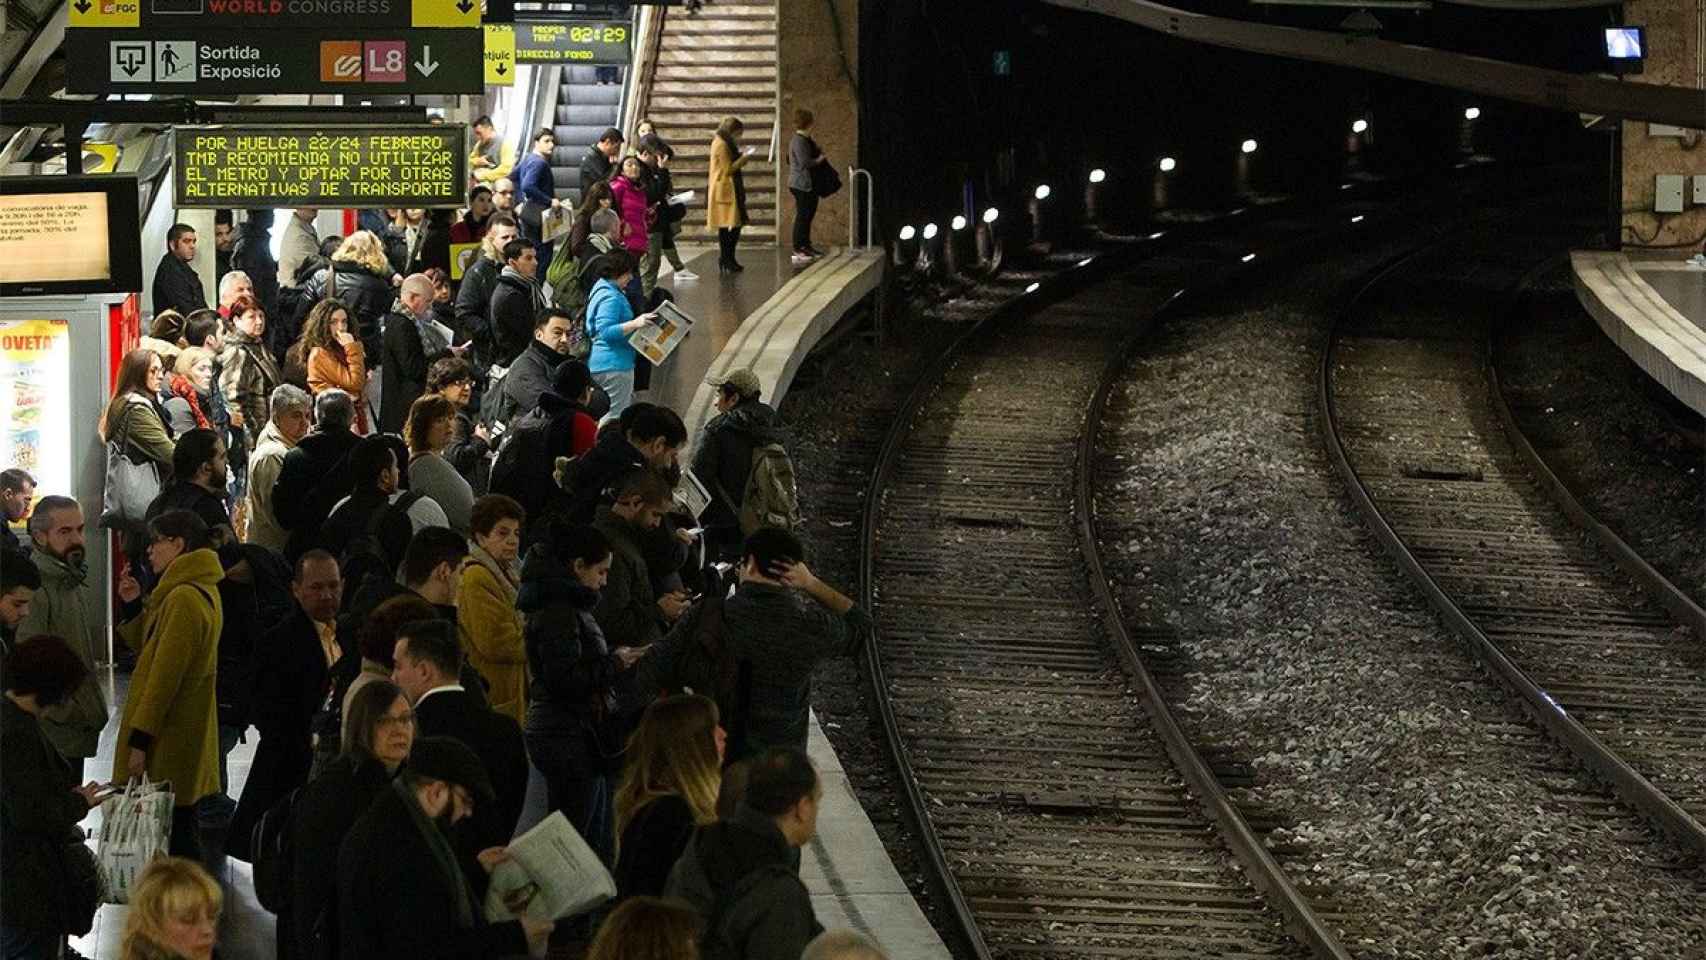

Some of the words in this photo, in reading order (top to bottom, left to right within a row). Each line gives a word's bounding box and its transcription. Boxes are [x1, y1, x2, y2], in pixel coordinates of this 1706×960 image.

[116, 4, 137, 13] FGC
[208, 0, 282, 13] WORLD
[288, 0, 391, 14] CONGRESS
[570, 26, 626, 43] 02:29
[200, 45, 260, 60] Sortida
[369, 49, 401, 73] L8
[200, 63, 281, 81] Exposició
[195, 136, 227, 150] POR
[237, 136, 300, 150] HUELGA
[308, 136, 361, 150] 22/24
[369, 136, 443, 150] FEBRERO
[185, 151, 217, 166] TMB
[226, 151, 330, 166] RECOMIENDA
[339, 151, 361, 166] NO
[369, 151, 453, 166] UTILIZAR
[185, 167, 207, 181] EL
[216, 167, 269, 181] METRO
[278, 167, 289, 181] Y
[299, 167, 351, 181] OPTAR
[360, 167, 392, 181] POR
[400, 167, 453, 181] OTRAS
[185, 182, 310, 197] ALTERNATIVAS
[319, 182, 340, 197] DE
[350, 182, 453, 197] TRANSPORTE
